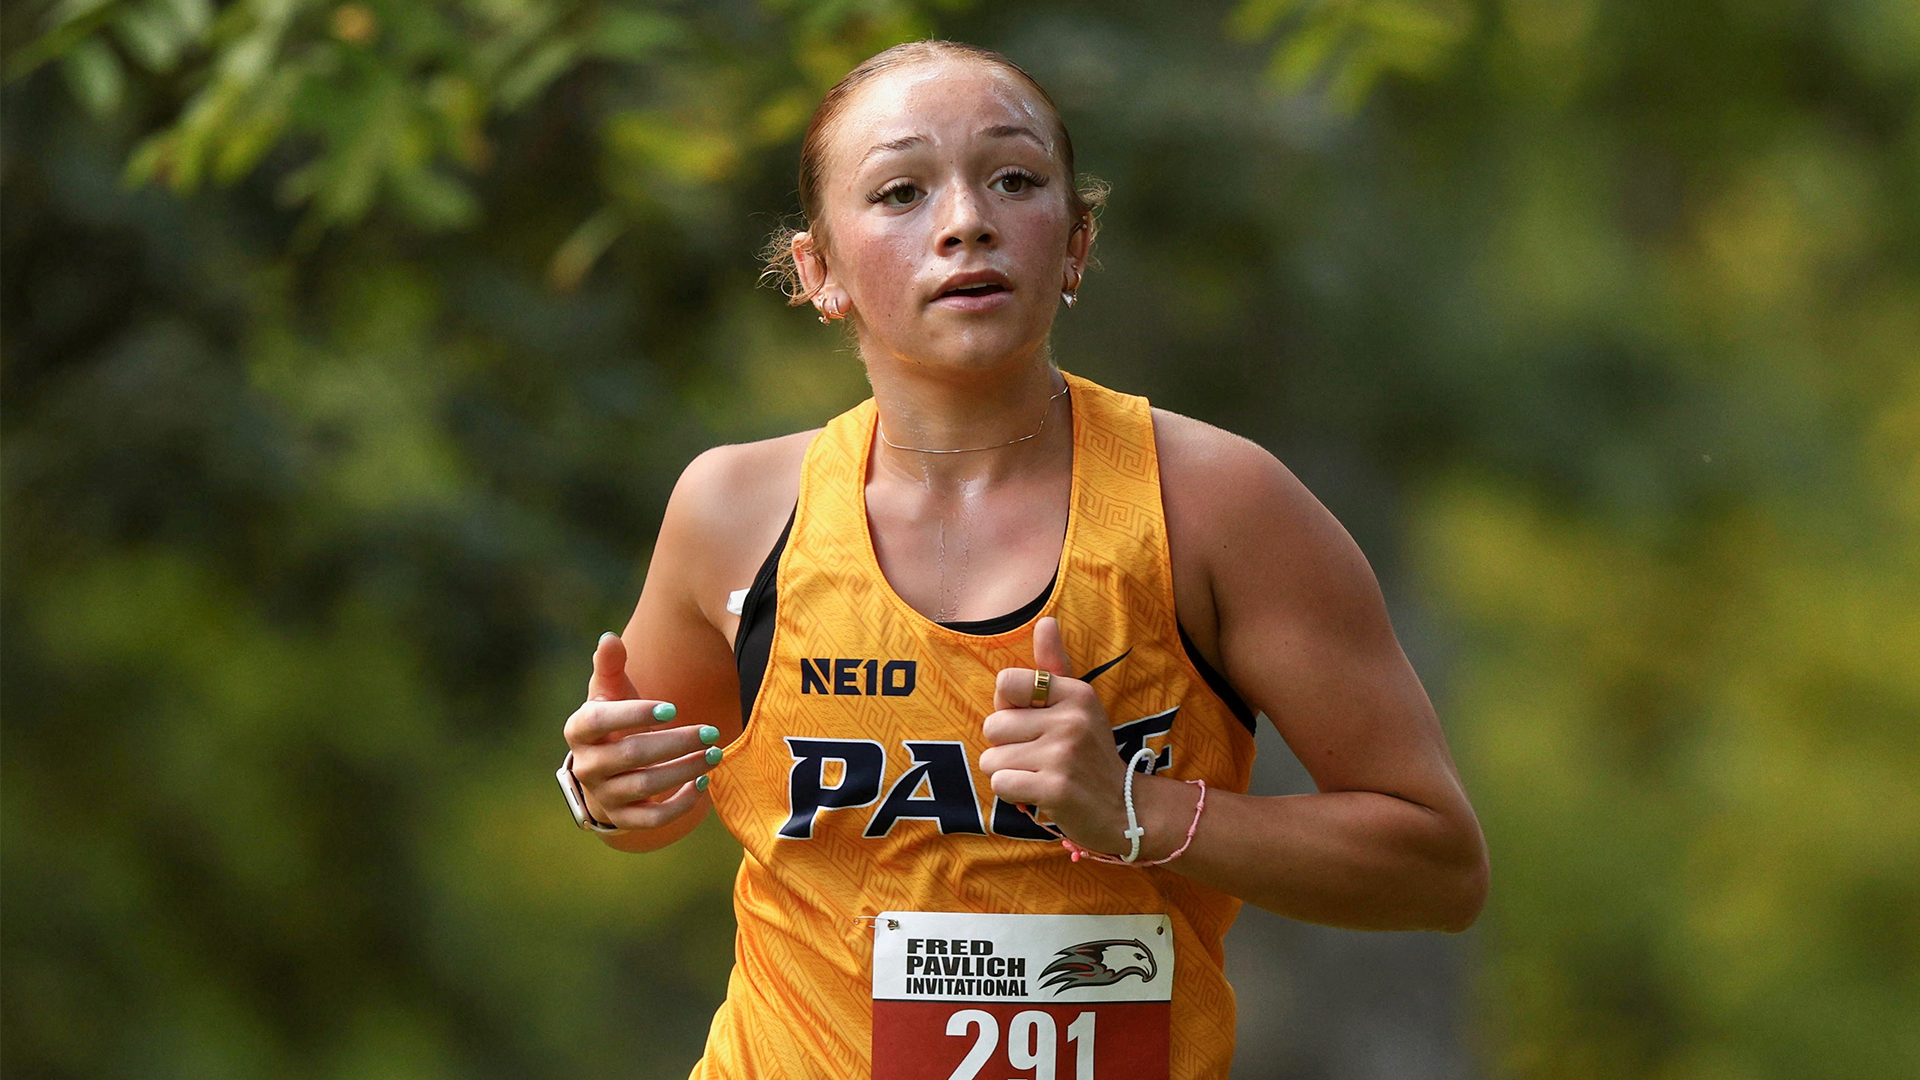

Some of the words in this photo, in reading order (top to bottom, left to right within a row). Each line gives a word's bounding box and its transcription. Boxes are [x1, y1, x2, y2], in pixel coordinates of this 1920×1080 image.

[800, 658, 917, 697] NE10
[907, 938, 994, 956] FRED
[906, 956, 1026, 978] PAVLICH
[906, 977, 1029, 997] INVITATIONAL
[945, 1008, 1097, 1080] 291
